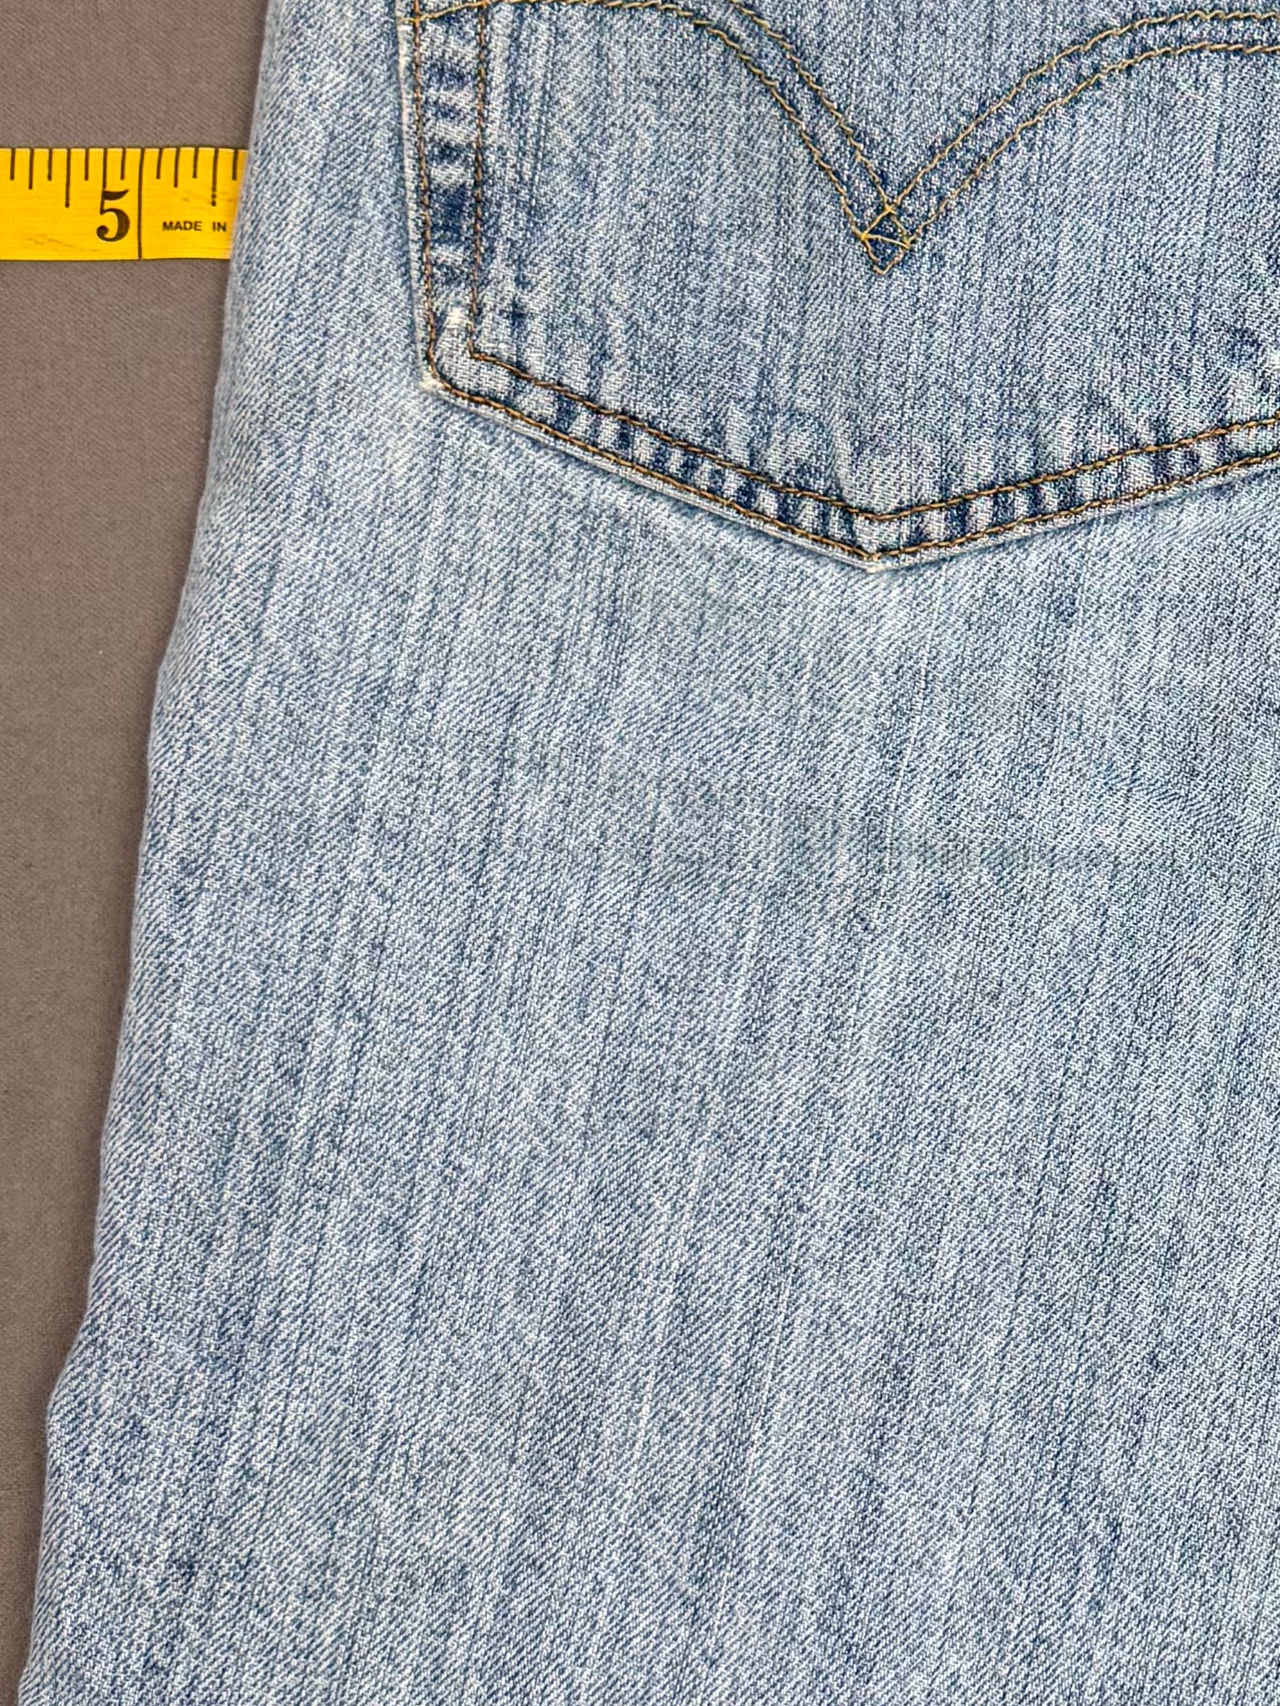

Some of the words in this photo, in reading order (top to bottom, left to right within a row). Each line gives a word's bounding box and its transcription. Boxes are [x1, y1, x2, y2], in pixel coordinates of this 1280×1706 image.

[96, 188, 131, 243] 5
[162, 220, 203, 233] MADE
[212, 220, 228, 233] IN
